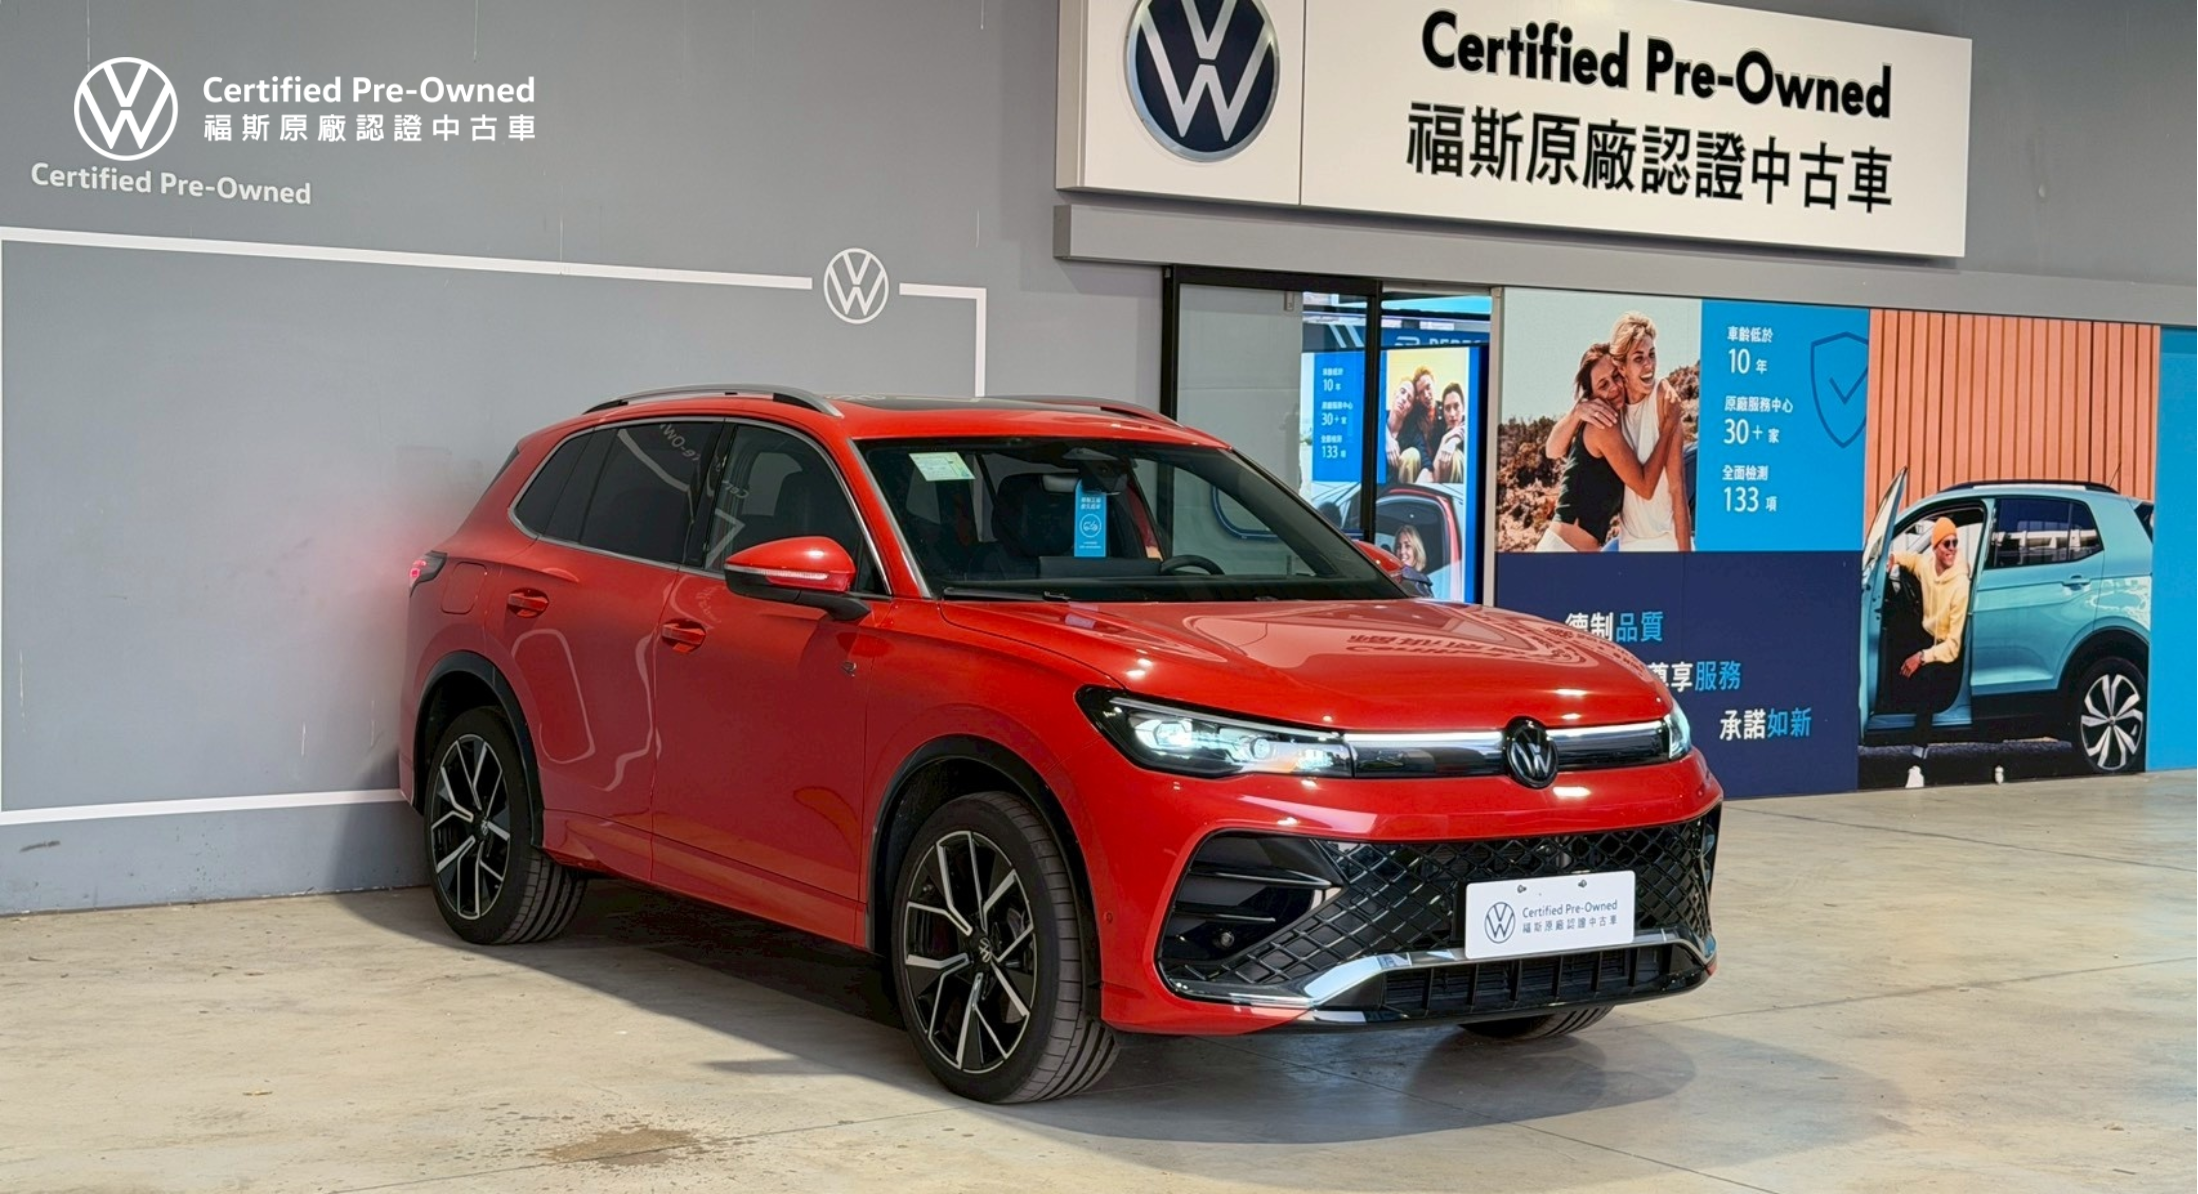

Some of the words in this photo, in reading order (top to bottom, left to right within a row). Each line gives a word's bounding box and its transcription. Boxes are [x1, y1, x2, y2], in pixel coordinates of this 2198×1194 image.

[1421, 11, 1629, 89] Certified
[1645, 36, 1892, 119] Pre-Owned
[1406, 101, 1893, 213] 福斯原廠認證中古車
[31, 162, 152, 194] Certified
[160, 171, 312, 205] Pre-Owned
[1727, 326, 1774, 343] 車齡低於
[1728, 348, 1750, 374] 10
[1755, 358, 1767, 375] 年
[1724, 395, 1794, 413] 原廠服務中心
[1768, 428, 1780, 444] 家
[1322, 445, 1339, 459] 133
[1722, 465, 1768, 481] 全面檢測
[1724, 486, 1759, 513] 133
[1719, 707, 1812, 741] 承諾如新
[1522, 903, 1563, 918] Certified
[1565, 899, 1618, 914] Pre-Owned
